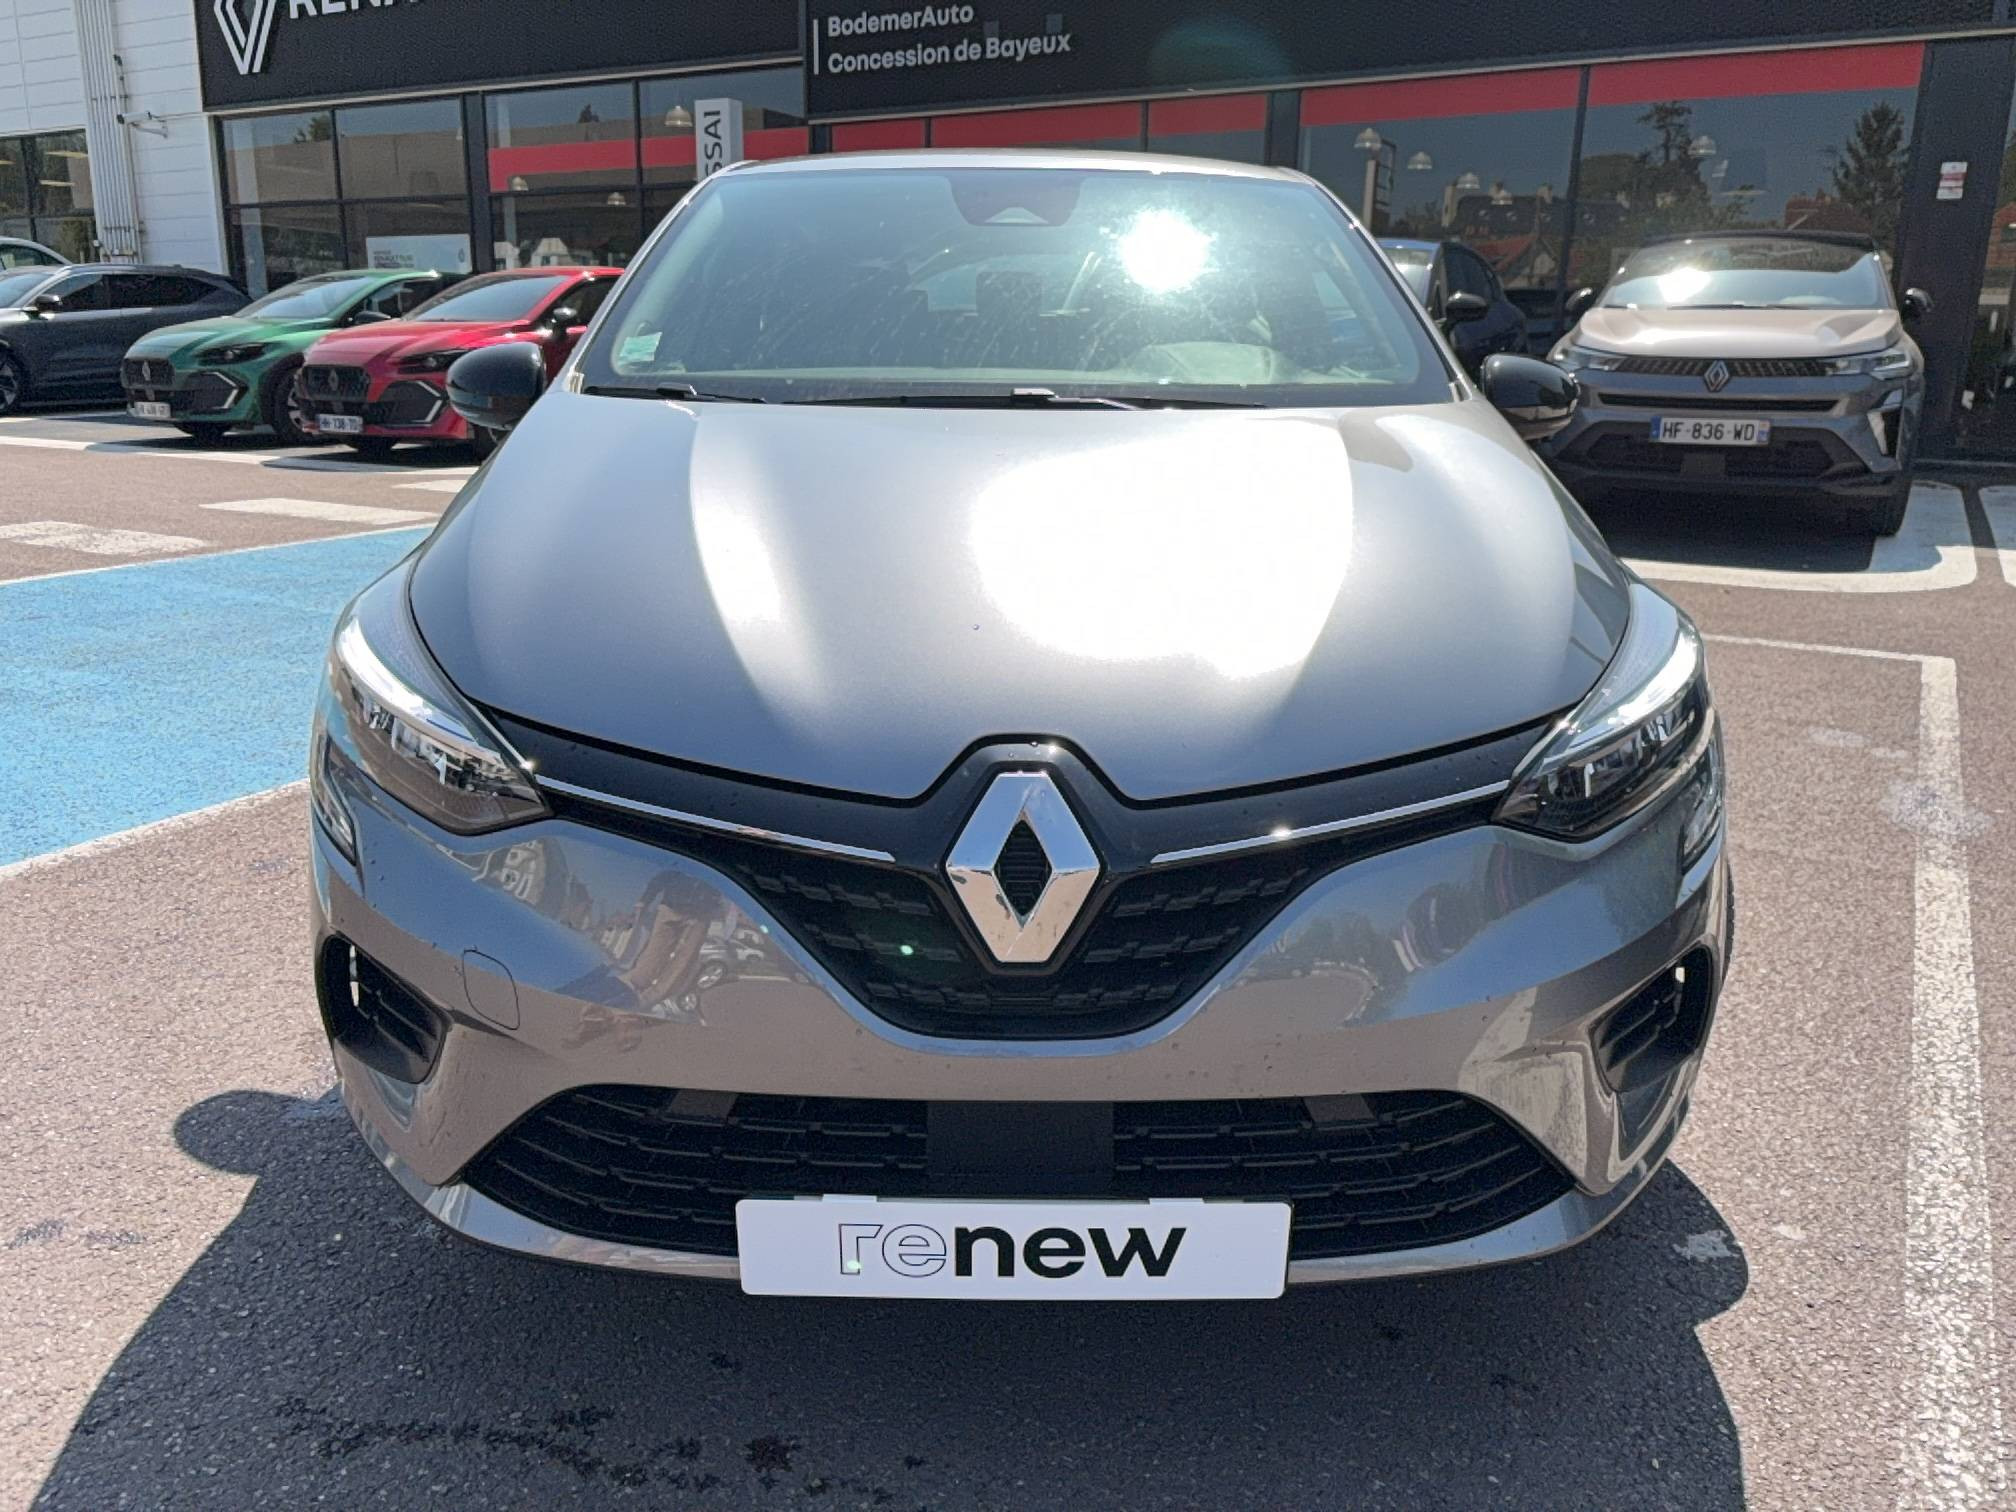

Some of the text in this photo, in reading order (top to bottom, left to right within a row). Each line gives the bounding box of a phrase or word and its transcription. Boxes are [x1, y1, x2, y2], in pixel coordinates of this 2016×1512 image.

[827, 5, 974, 38] BodemerAuto
[827, 33, 1072, 74] Concession de Bayeux
[838, 1223, 1187, 1279] renew
